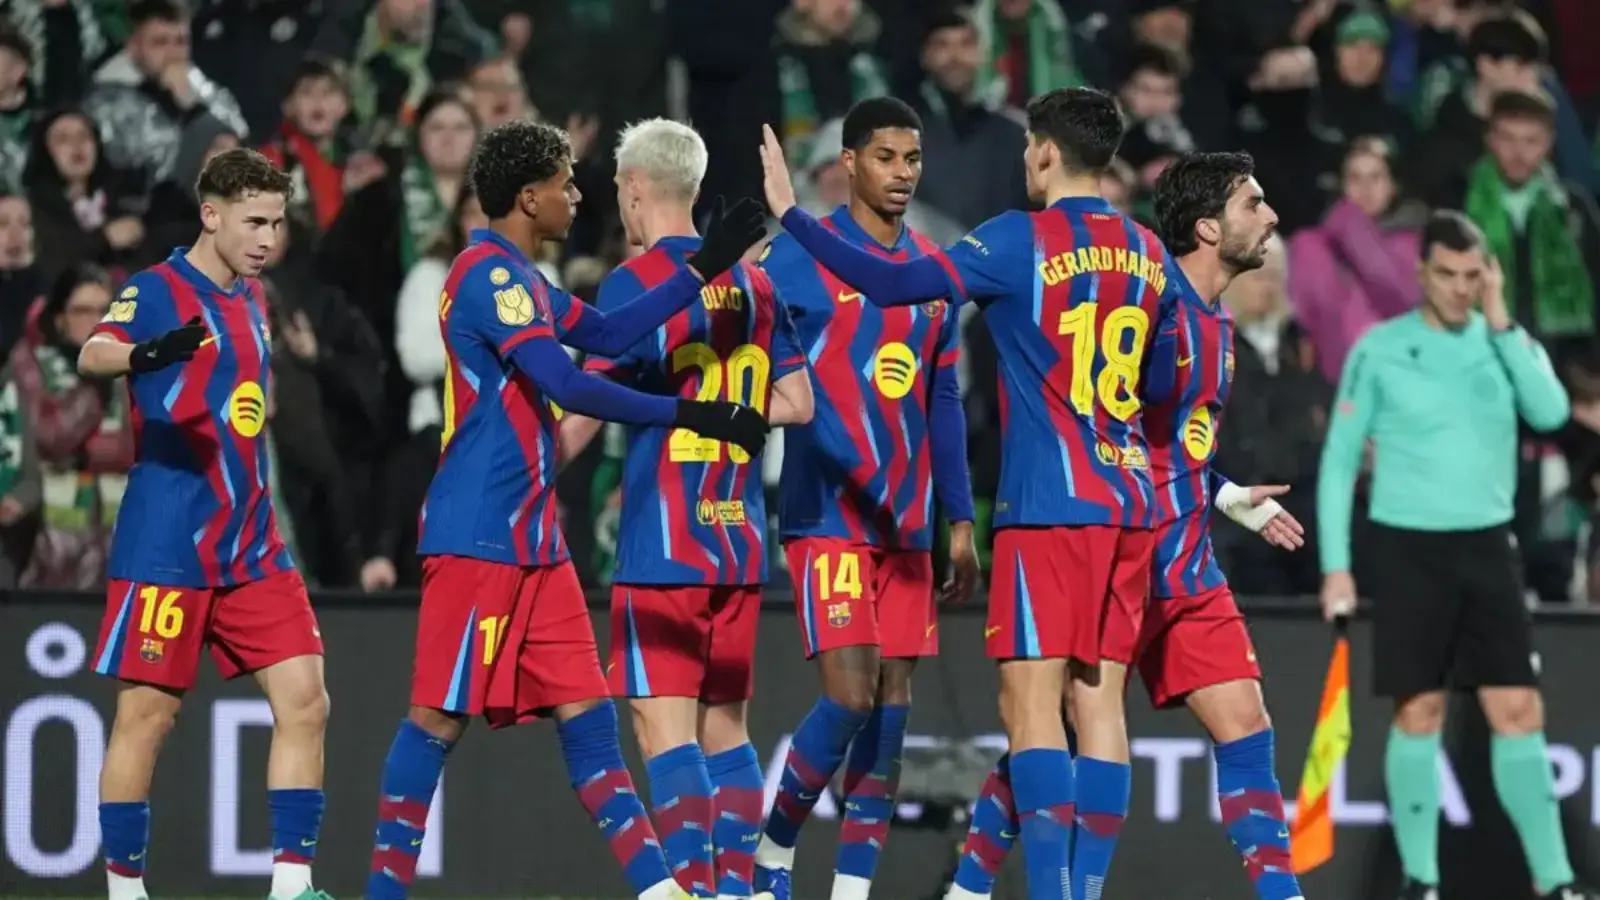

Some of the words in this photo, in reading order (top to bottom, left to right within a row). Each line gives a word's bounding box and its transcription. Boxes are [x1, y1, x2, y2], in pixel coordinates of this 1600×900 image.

[1038, 246, 1113, 286] GERARD
[1114, 247, 1167, 297] MARTÍN
[1057, 301, 1150, 422] 18
[669, 341, 771, 465] 20
[813, 551, 863, 601] 14
[138, 585, 184, 639] 16
